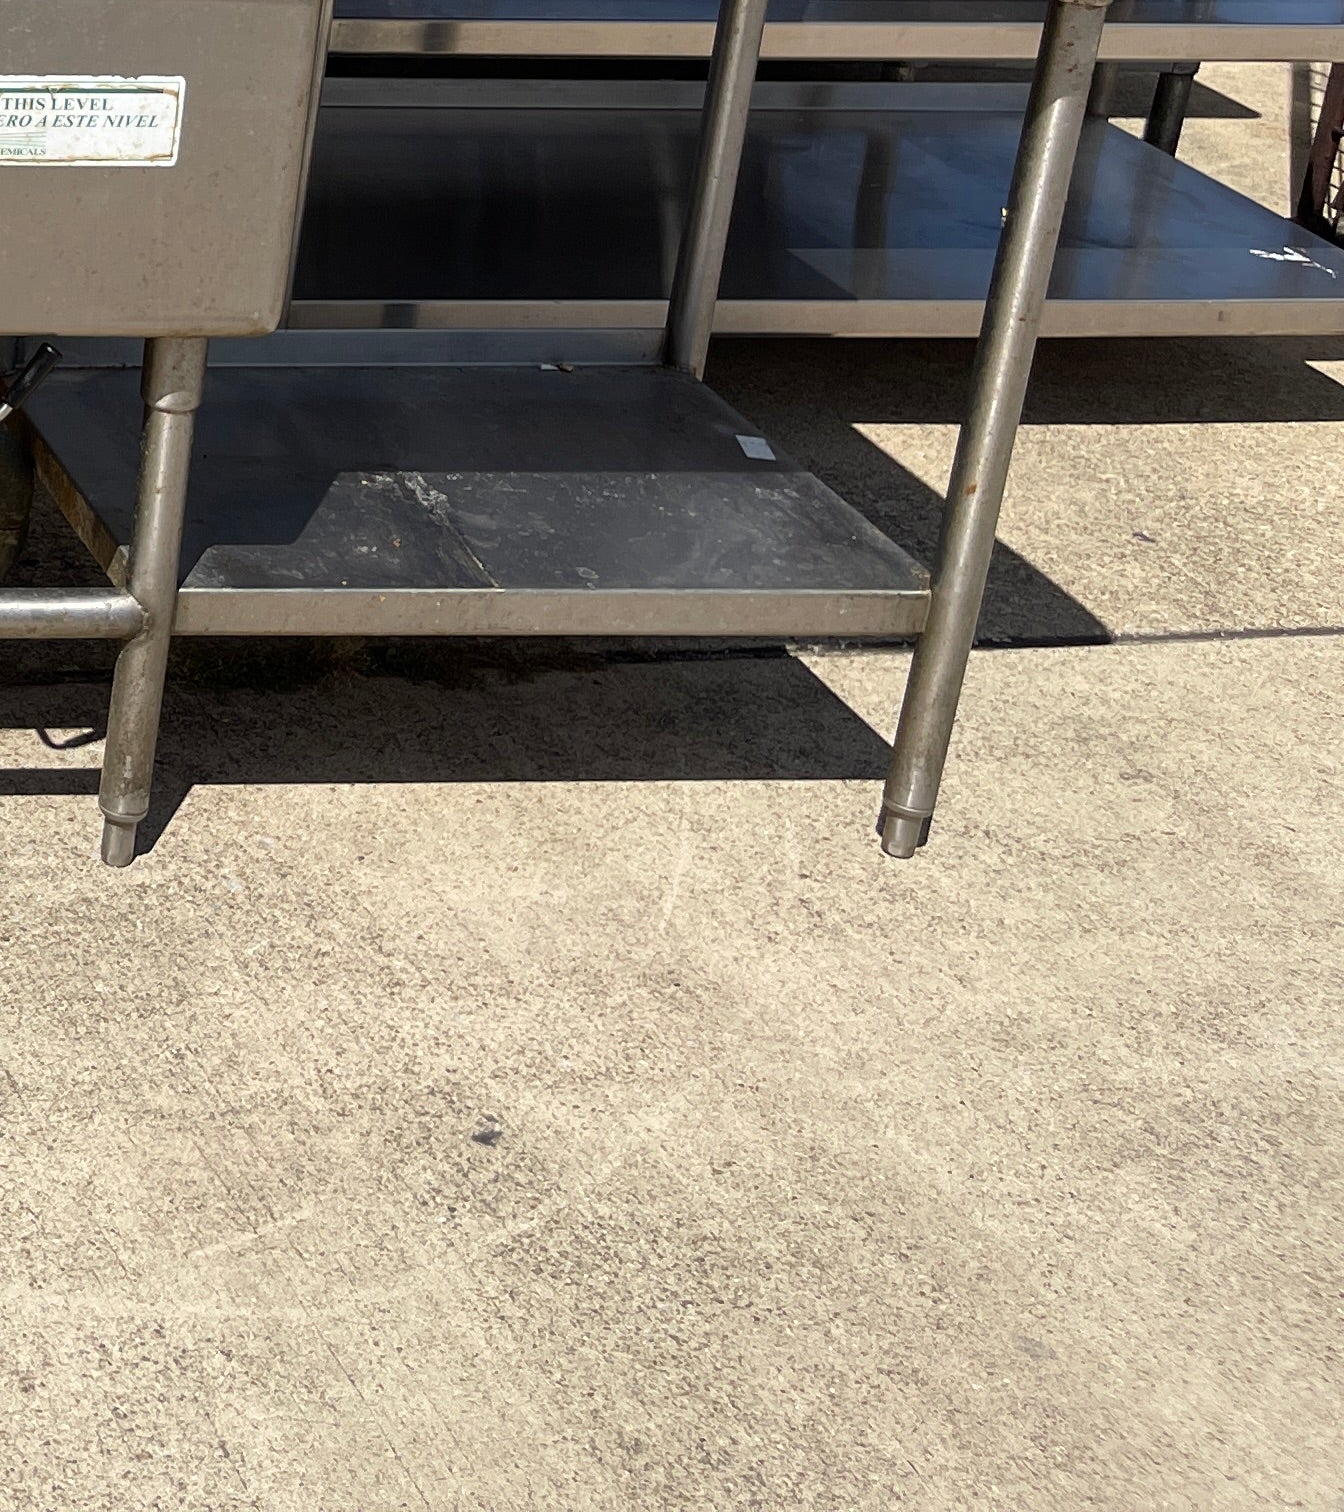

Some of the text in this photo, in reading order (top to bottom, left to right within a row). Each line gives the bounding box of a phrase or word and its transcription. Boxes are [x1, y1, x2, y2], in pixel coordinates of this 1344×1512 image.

[1, 97, 46, 111] THIS
[50, 97, 113, 111] LEVEL
[35, 114, 48, 128] A
[52, 114, 99, 128] ESTE
[102, 114, 160, 128] NIVEL
